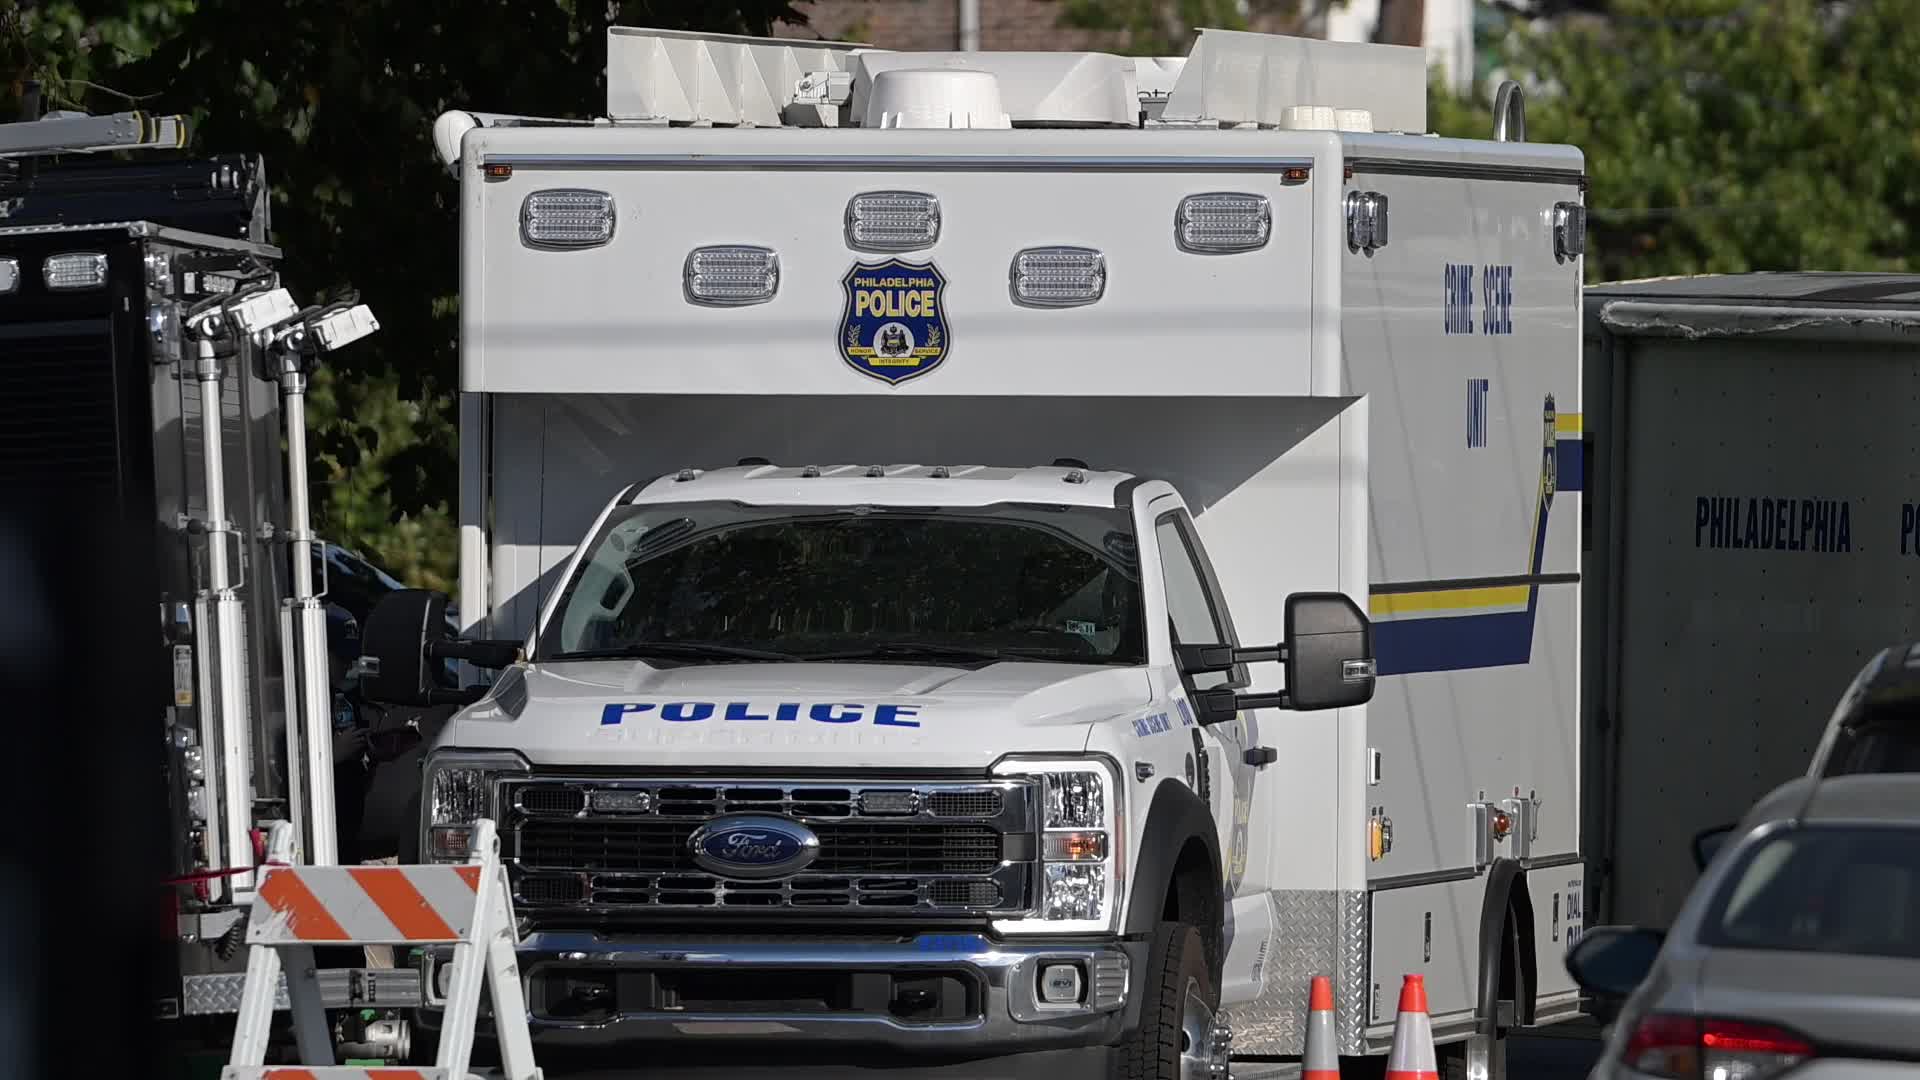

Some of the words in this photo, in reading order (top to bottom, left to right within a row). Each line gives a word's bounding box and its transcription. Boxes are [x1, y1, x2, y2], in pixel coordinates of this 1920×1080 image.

[854, 277, 934, 288] PHILADELPHIA
[855, 290, 935, 317] POLICE
[1444, 263, 1474, 335] CRIME
[1482, 264, 1512, 335] SCENE
[1466, 378, 1489, 448] UNIT
[1695, 496, 1851, 553] PHILADELPHIA
[600, 702, 922, 727] POLICE
[722, 832, 782, 858] Ford
[1567, 891, 1581, 920] DIAL
